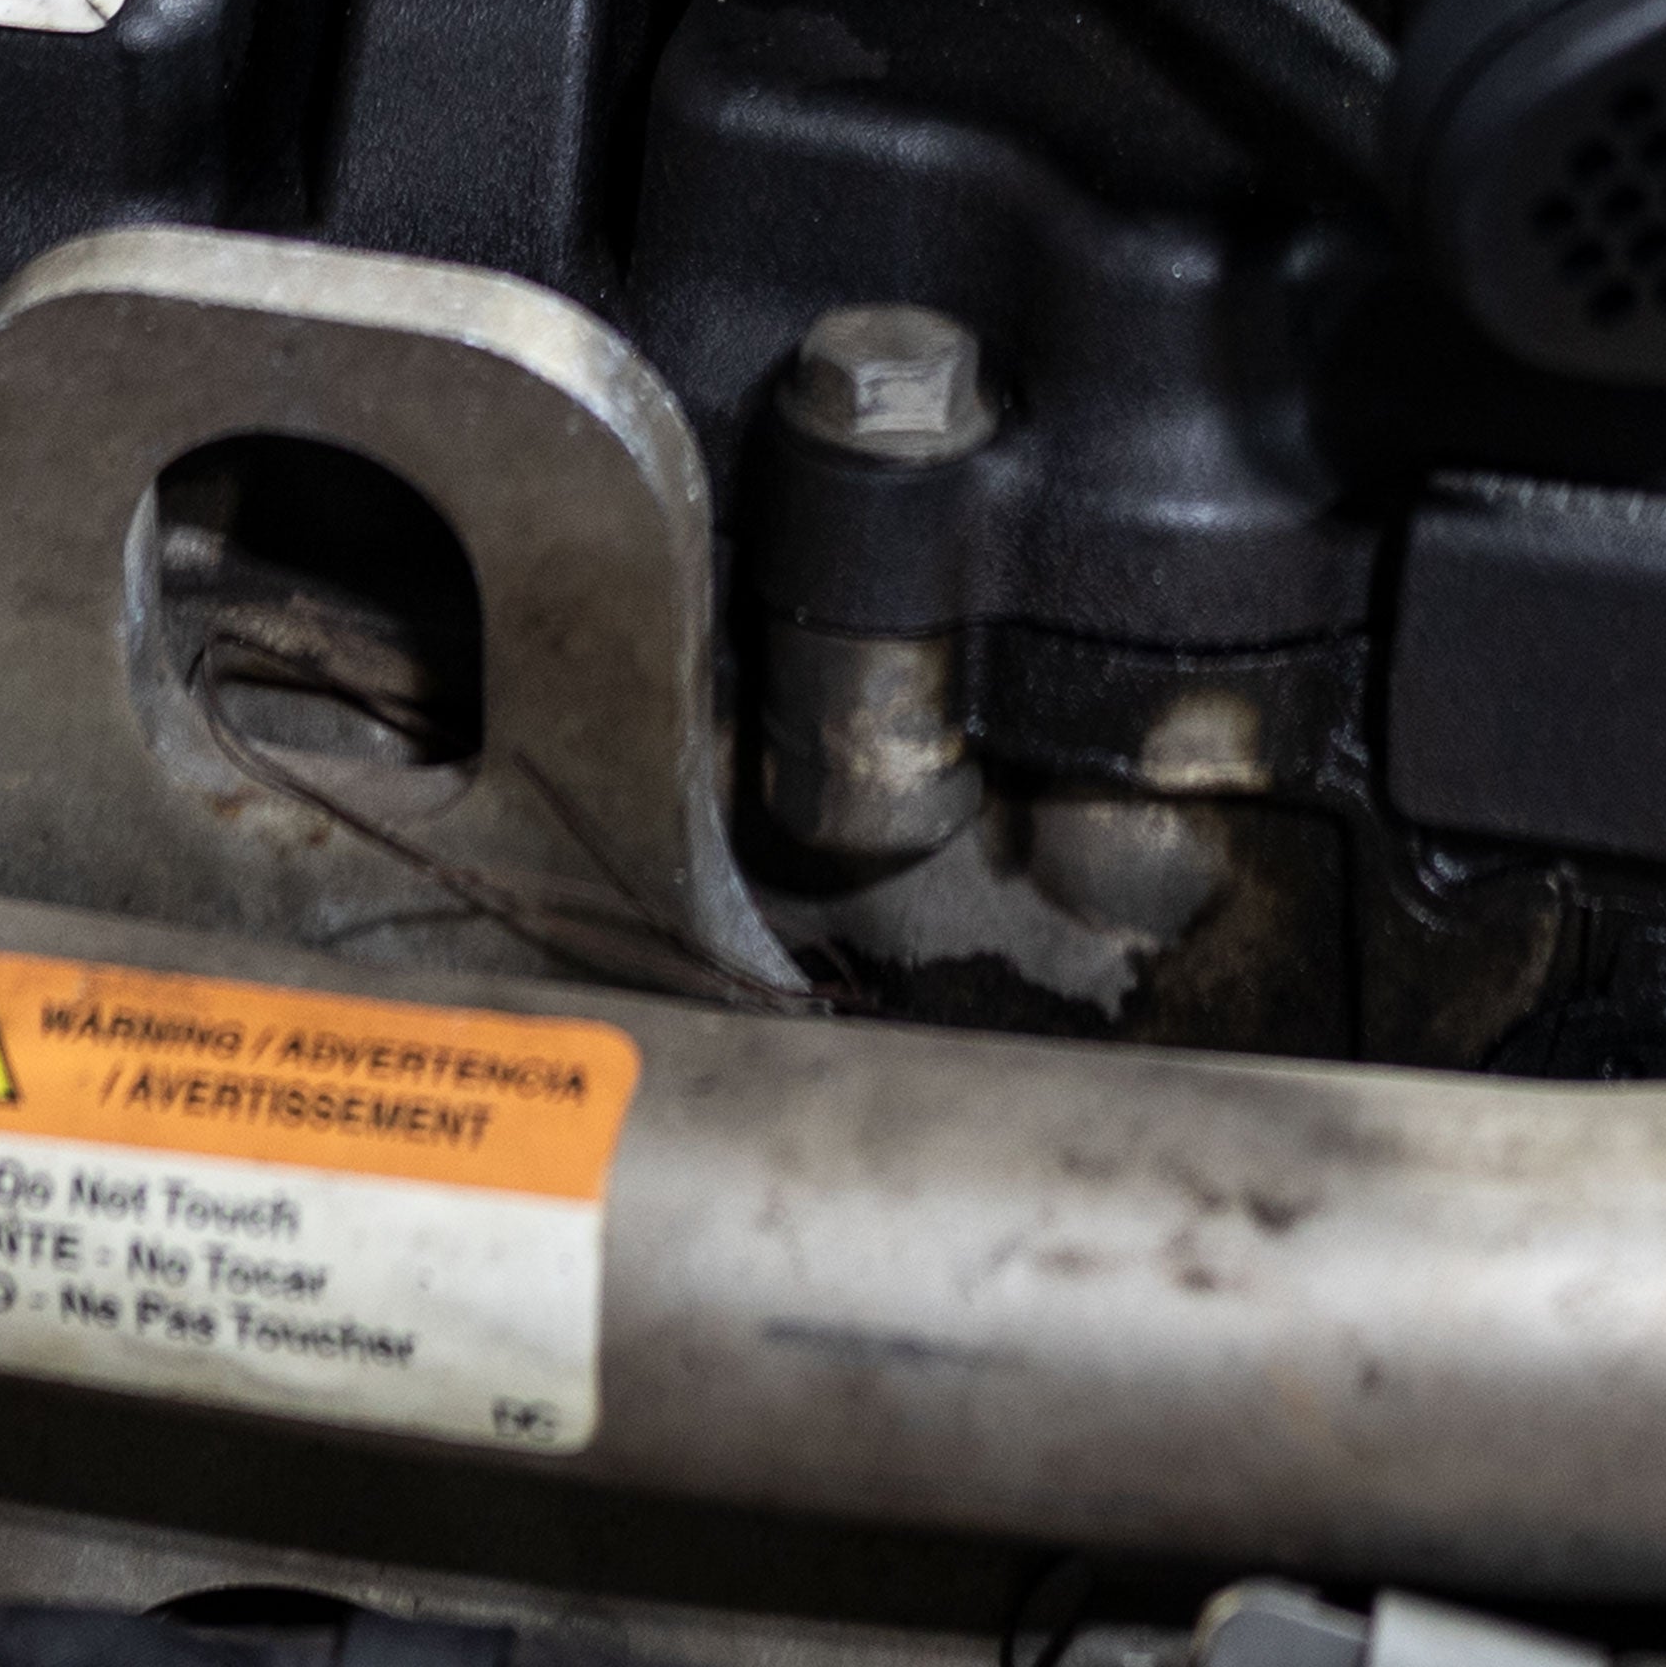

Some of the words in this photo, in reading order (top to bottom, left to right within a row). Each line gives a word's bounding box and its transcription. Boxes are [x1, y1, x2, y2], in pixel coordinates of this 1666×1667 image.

[39, 1000, 243, 1061] WARNING
[284, 1031, 591, 1107] ADVERTENCIA
[127, 1071, 493, 1148] AVERTISSEMENT
[70, 1165, 148, 1220] Not
[163, 1181, 300, 1238] Touch
[128, 1240, 189, 1287] No
[205, 1246, 327, 1296] Tocar
[60, 1282, 121, 1327] Ne
[136, 1291, 215, 1346] Pas
[232, 1301, 415, 1363] Toucher
